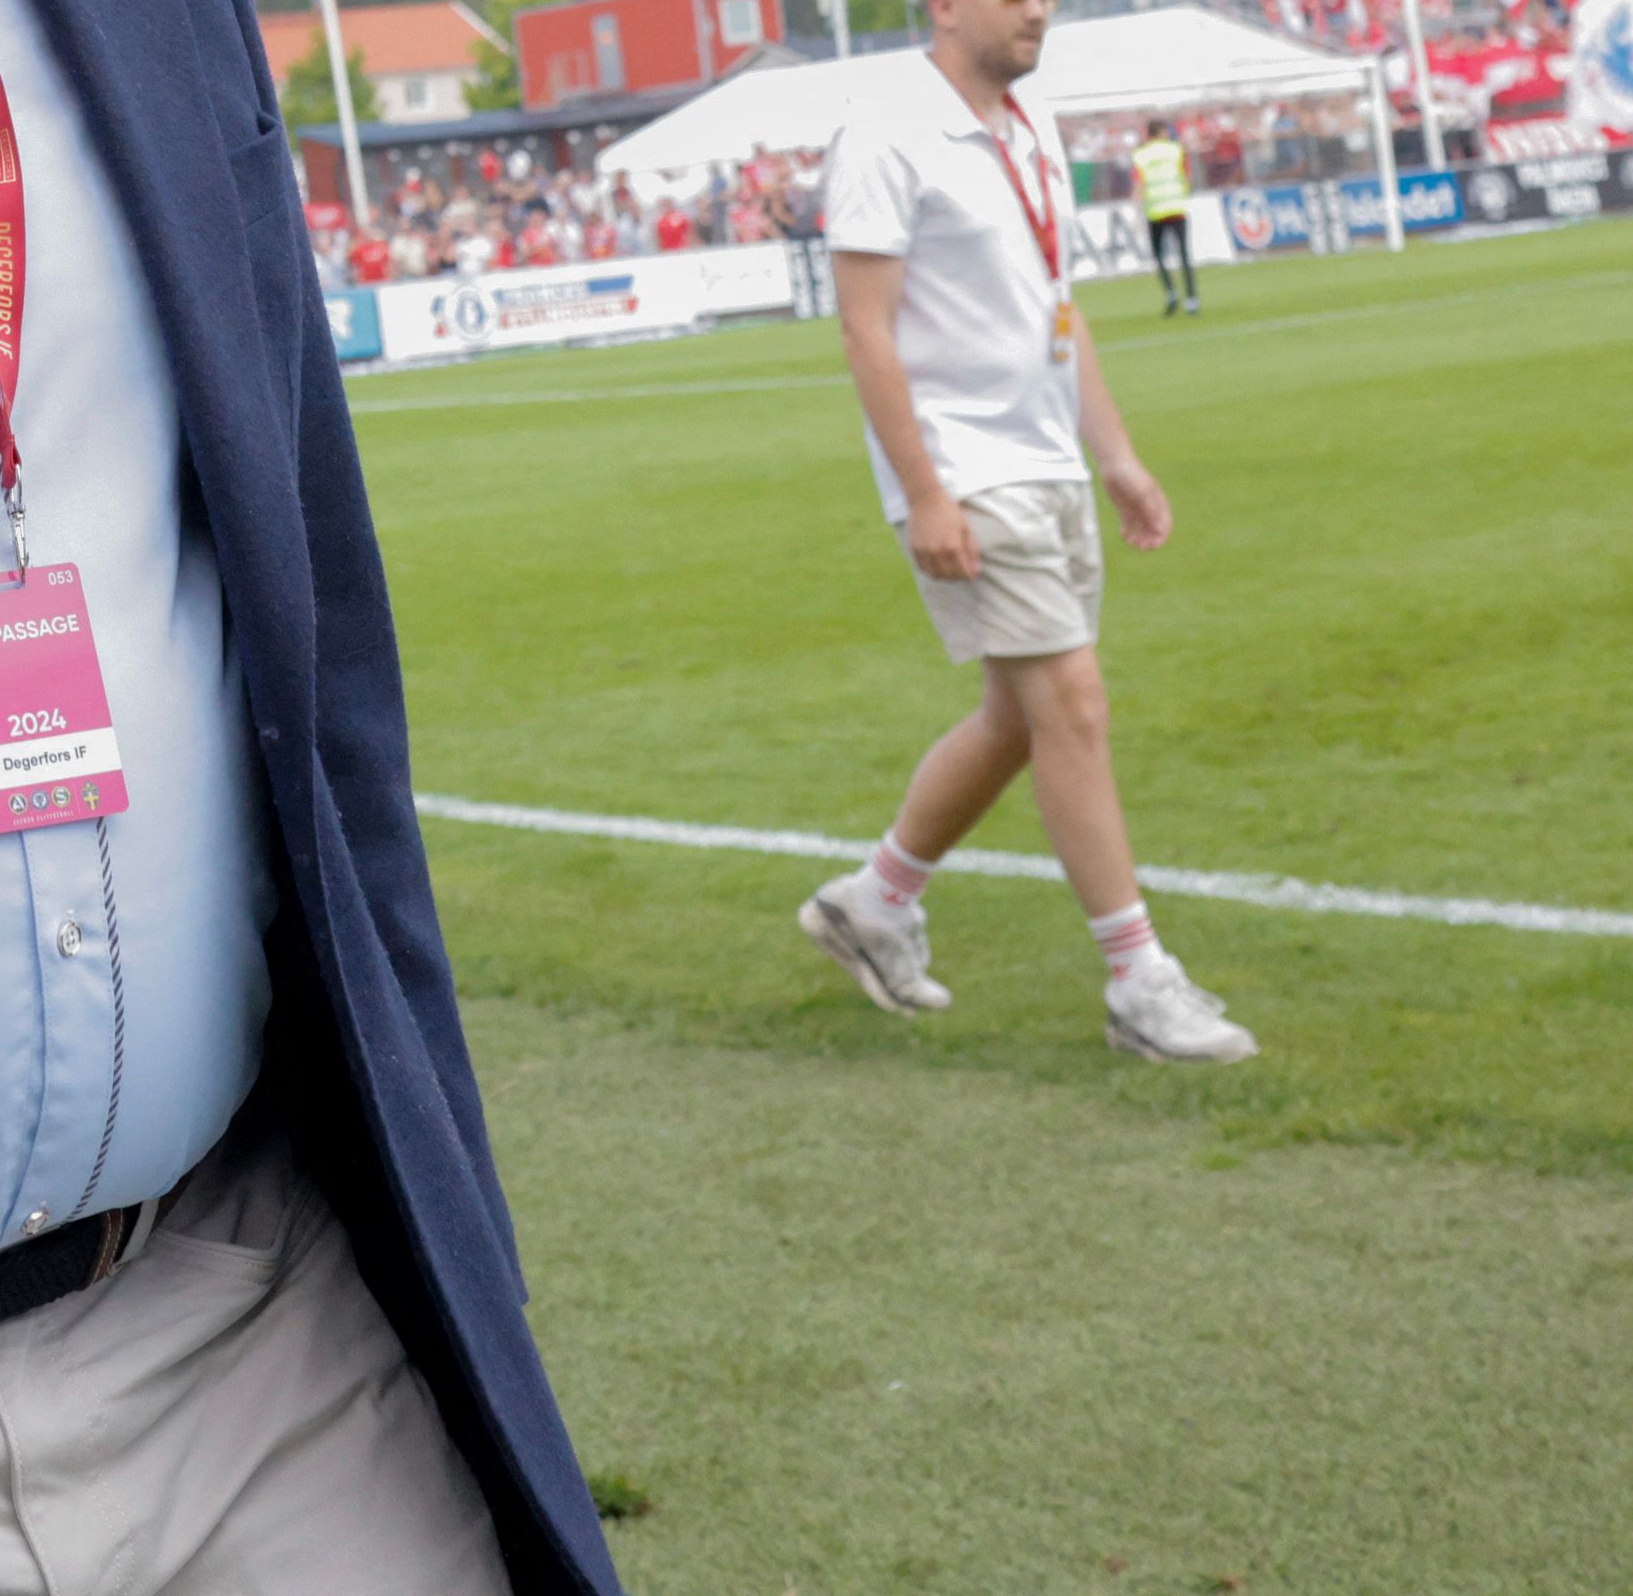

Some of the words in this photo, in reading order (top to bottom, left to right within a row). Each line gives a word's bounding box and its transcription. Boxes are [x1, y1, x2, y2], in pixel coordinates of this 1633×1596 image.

[47, 570, 74, 586] 053
[7, 707, 67, 738] 2024
[3, 750, 72, 771] Degerfors
[74, 745, 87, 759] IF
